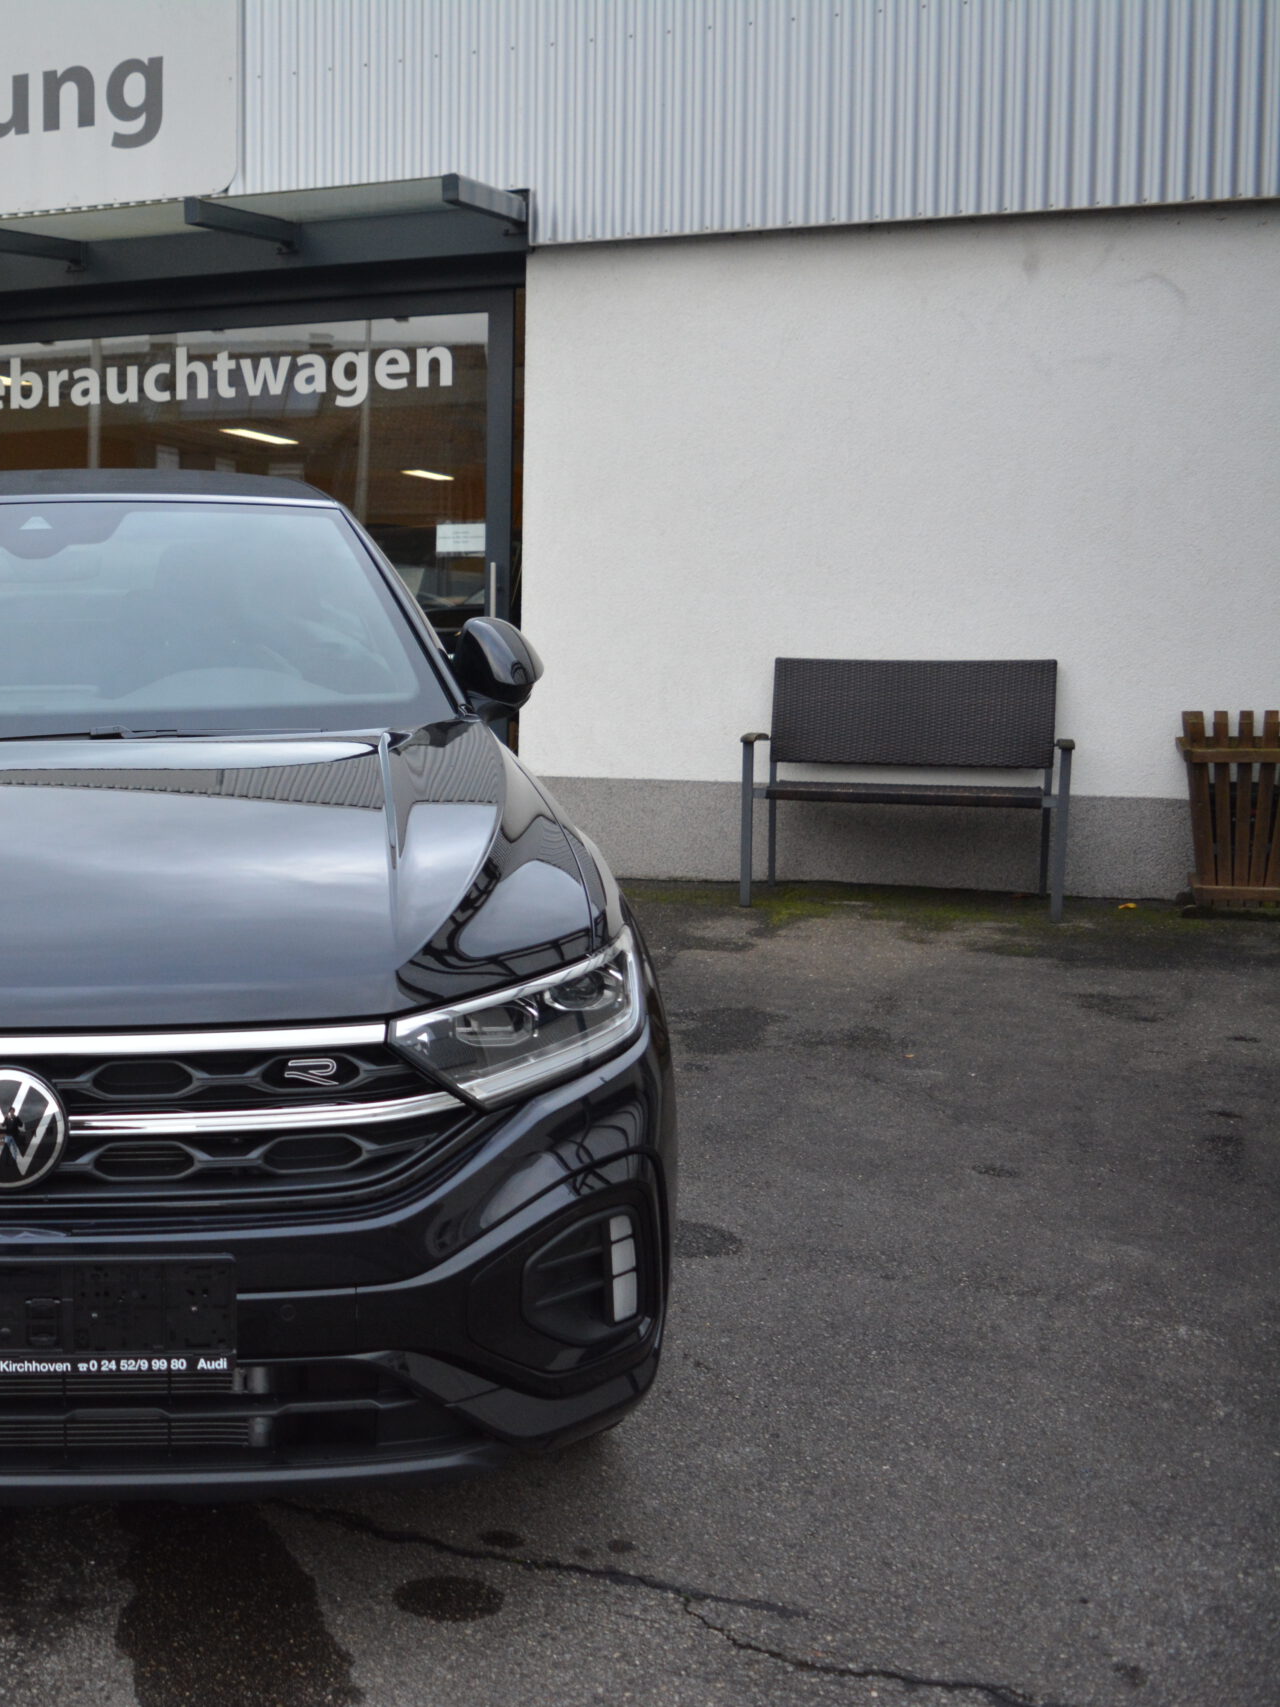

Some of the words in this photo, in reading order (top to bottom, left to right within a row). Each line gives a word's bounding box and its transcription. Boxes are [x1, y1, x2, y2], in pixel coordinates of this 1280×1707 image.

[100, 1359, 117, 1371] 24
[120, 1358, 149, 1371] 52/9
[151, 1358, 168, 1370] 99
[170, 1358, 188, 1370] 80
[197, 1357, 229, 1371] Audi
